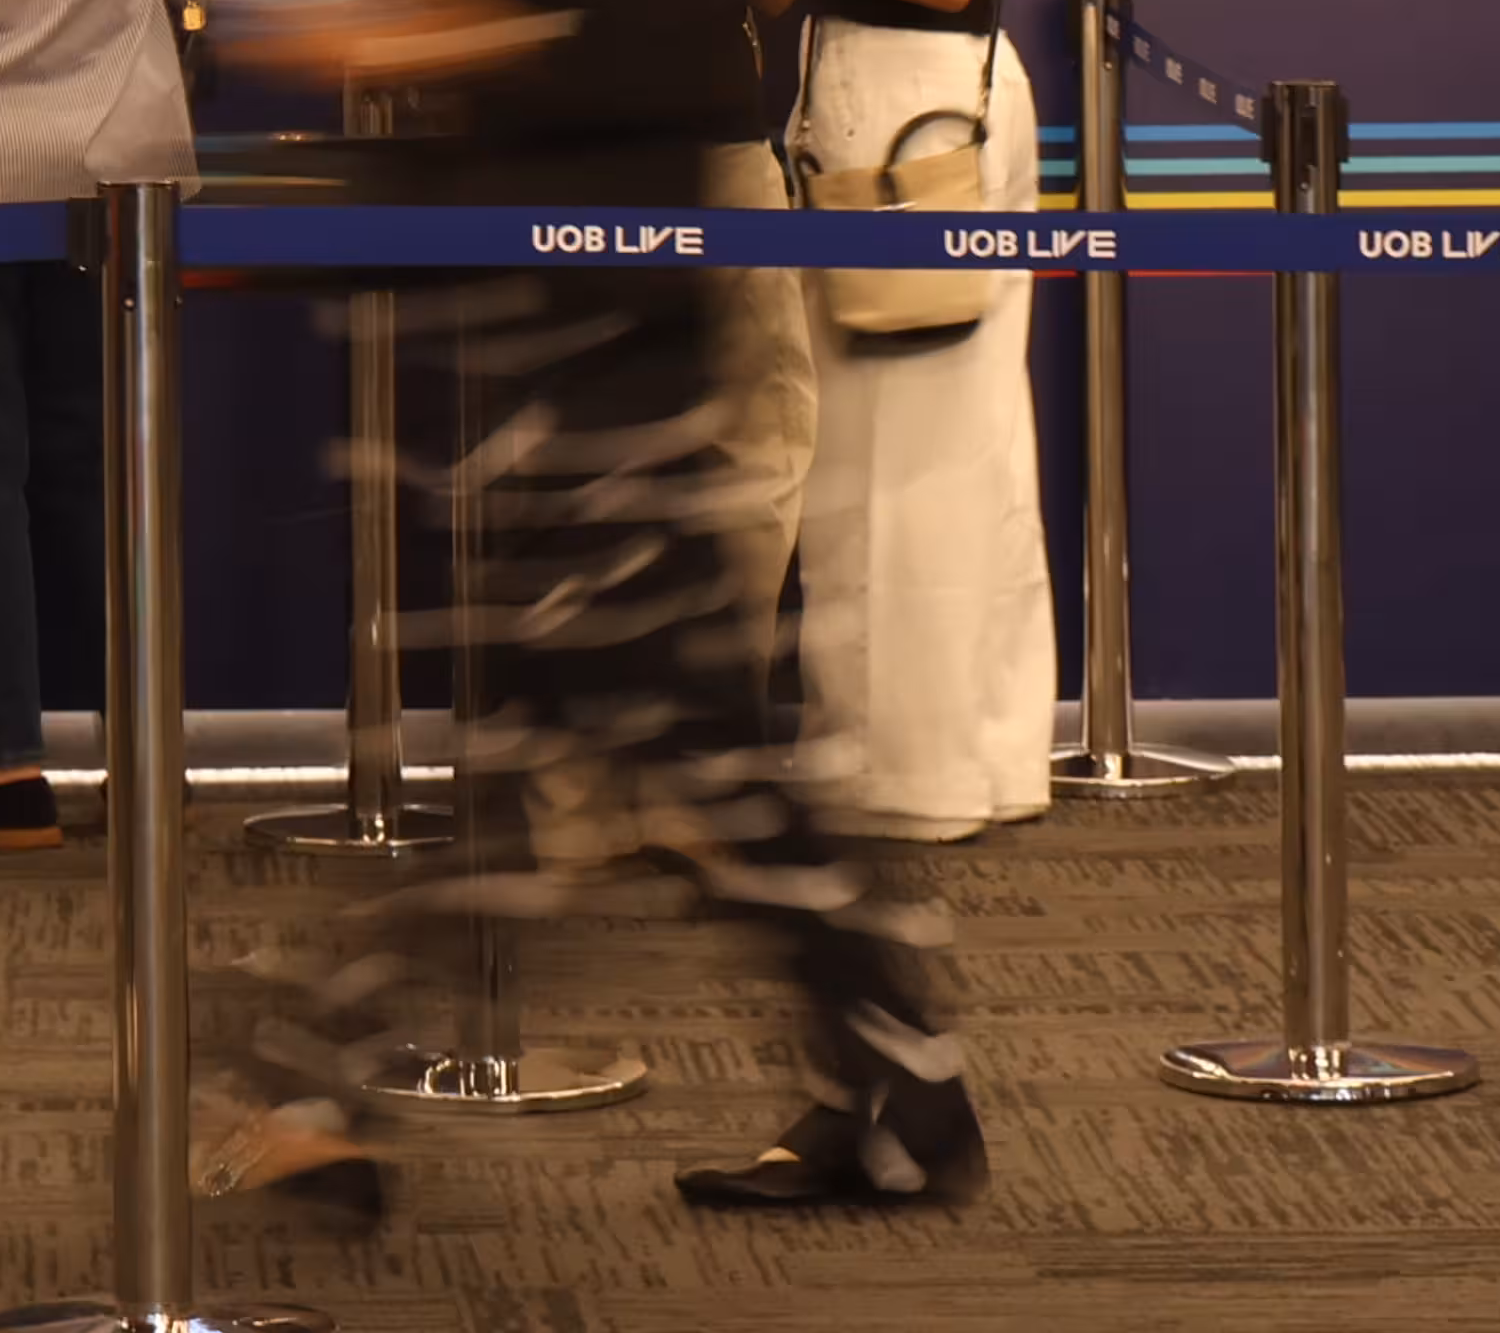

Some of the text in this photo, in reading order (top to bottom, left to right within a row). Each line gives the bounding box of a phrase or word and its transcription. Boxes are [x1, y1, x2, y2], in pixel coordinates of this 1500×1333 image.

[531, 225, 704, 255] UOB LIVE
[944, 230, 1116, 259] UOB LIVE
[1358, 230, 1432, 259] UOB
